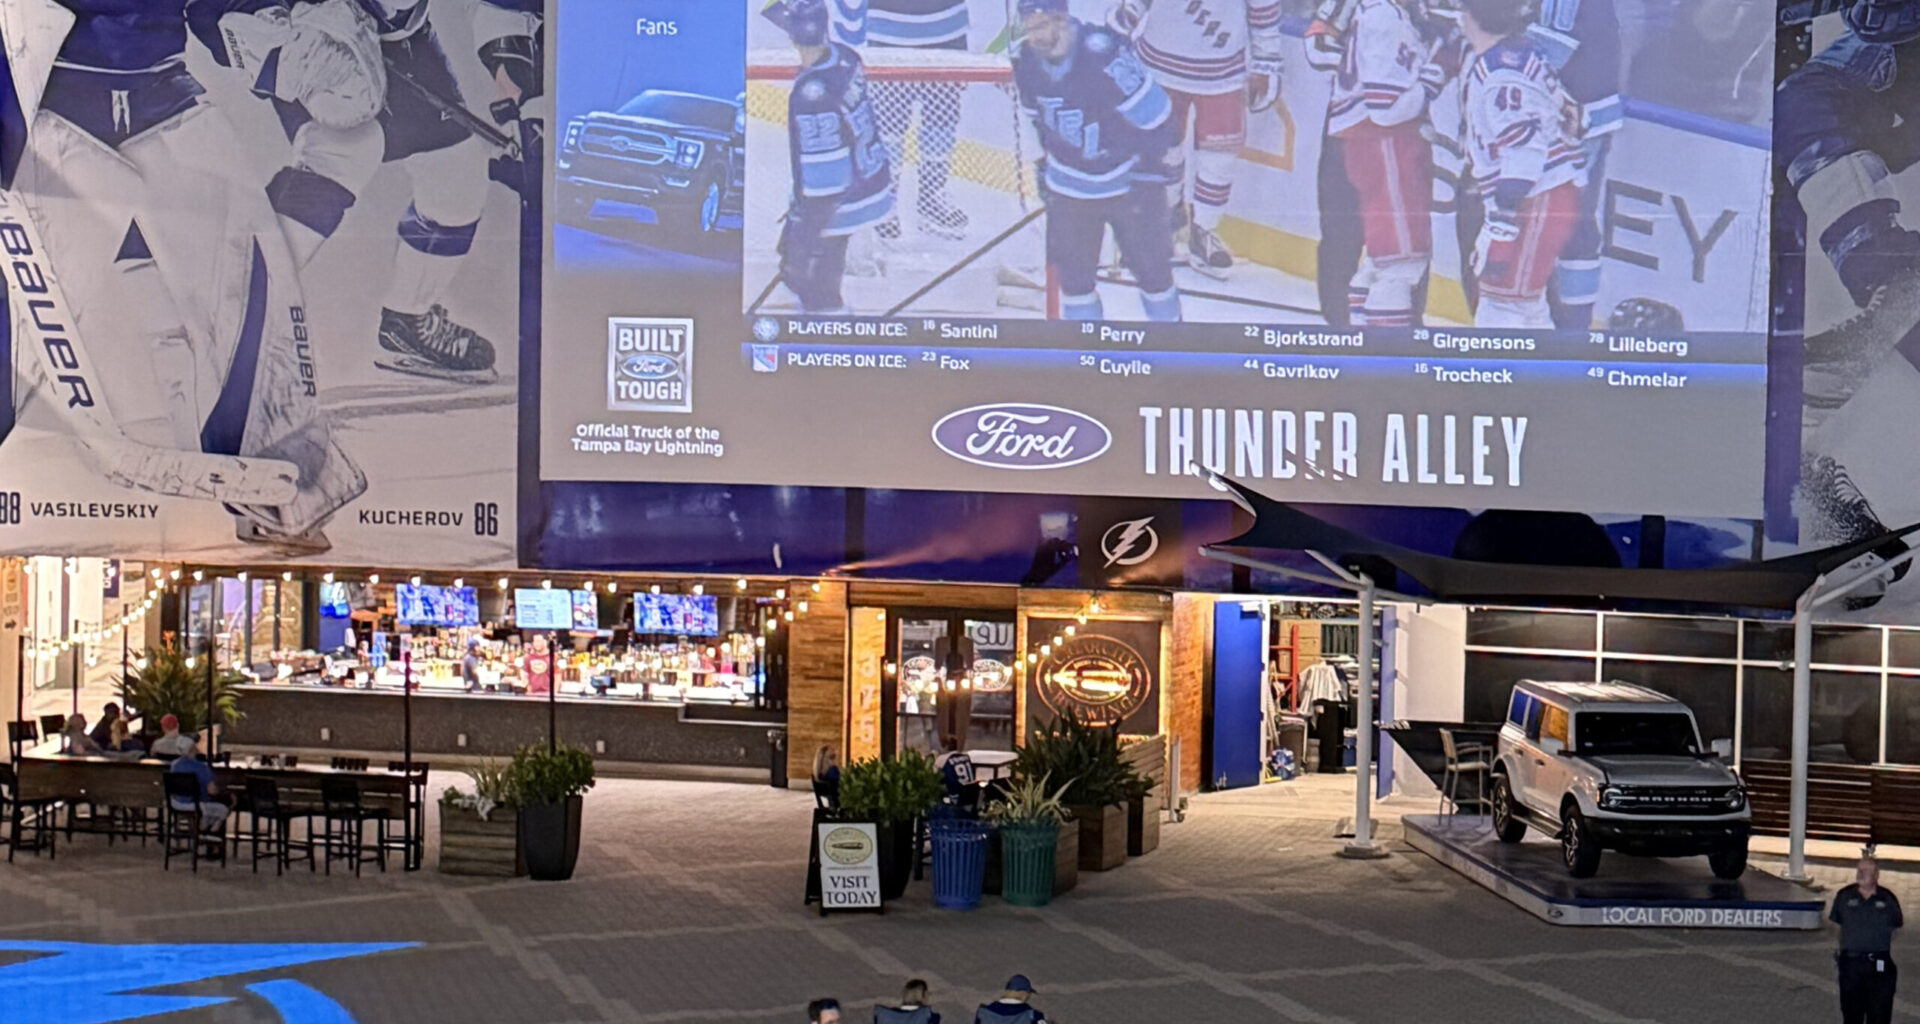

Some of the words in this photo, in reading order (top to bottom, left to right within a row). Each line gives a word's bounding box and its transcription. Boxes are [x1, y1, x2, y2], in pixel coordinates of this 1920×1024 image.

[636, 17, 678, 36] Fans
[1495, 85, 1522, 112] 49
[617, 328, 683, 352] BUILT
[788, 320, 852, 336] PLAYERS
[854, 322, 876, 336] ON
[879, 323, 907, 337] ICE:
[940, 322, 998, 339] Santini
[1081, 322, 1095, 335] 10
[1100, 326, 1146, 346] Perry
[1244, 325, 1260, 337] 22
[1263, 329, 1364, 348] Bjorkstrand
[1432, 332, 1536, 353] Girgensons
[1608, 335, 1689, 357] Lilleberg
[632, 358, 665, 375] Ford
[787, 352, 851, 367] PLAYERS
[854, 354, 876, 367] ON
[879, 355, 907, 368] ICE:
[922, 351, 937, 362] 23
[940, 355, 970, 371] Fox
[1080, 354, 1096, 367] 50
[1099, 358, 1152, 378] Cuylle
[1243, 359, 1259, 371] 44
[1263, 362, 1340, 379] Gavrikov
[1432, 366, 1514, 383] Trocheck
[1587, 366, 1605, 378] 49
[1607, 370, 1688, 388] Chmelar
[616, 380, 682, 401] TOUGH
[576, 423, 628, 440] Official
[632, 425, 672, 440] Truck
[675, 427, 693, 440] of
[694, 427, 720, 441] the
[965, 410, 1073, 460] Ford
[571, 438, 621, 454] Tampa
[625, 439, 652, 456] Bay
[654, 440, 724, 457] Lightning
[1139, 407, 1359, 480] THUNDER
[1383, 413, 1528, 486] ALLEY
[30, 502, 159, 519] VASILEVSKIY
[359, 509, 463, 526] KUCHEROV
[474, 502, 498, 536] 86
[829, 875, 869, 889] VISIT
[825, 891, 876, 905] TODAY
[1602, 907, 1656, 924] LOCAL
[1661, 908, 1706, 925] FORD
[1712, 909, 1782, 927] DEALERS
